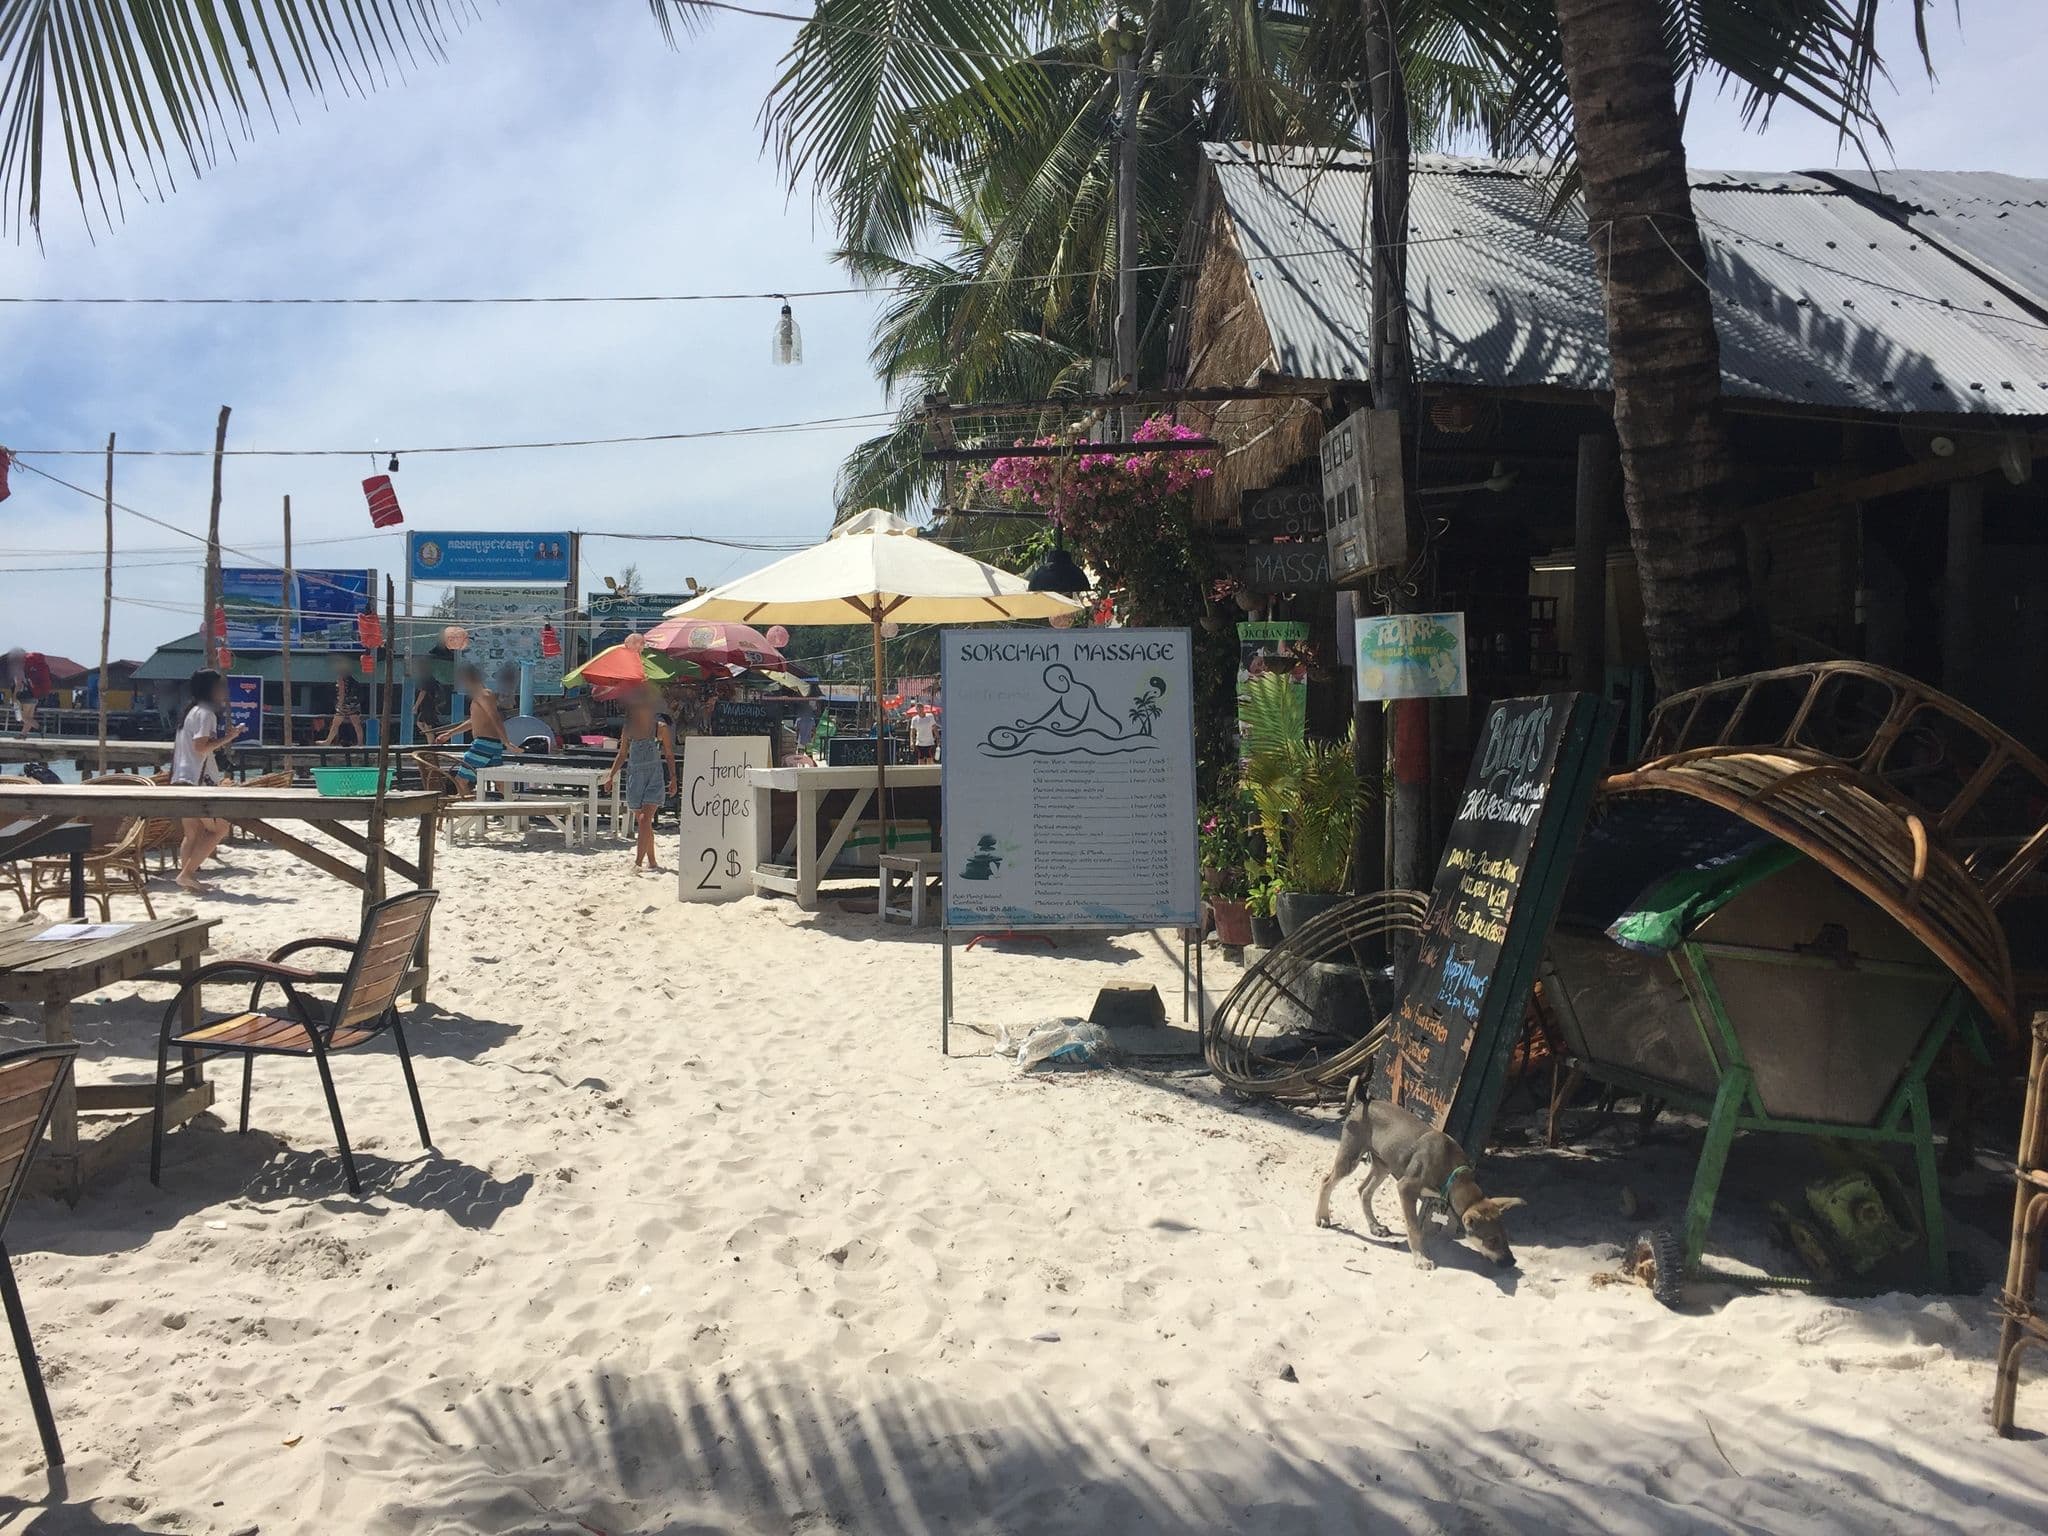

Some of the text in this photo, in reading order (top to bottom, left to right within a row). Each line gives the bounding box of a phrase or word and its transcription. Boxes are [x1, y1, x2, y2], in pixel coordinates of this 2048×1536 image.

[1252, 492, 1324, 519] COCON
[1286, 517, 1319, 533] OIL
[1255, 553, 1329, 583] MASSA
[961, 643, 1174, 662] SOKCHAN MASSAGE
[692, 776, 750, 840] Crêpes
